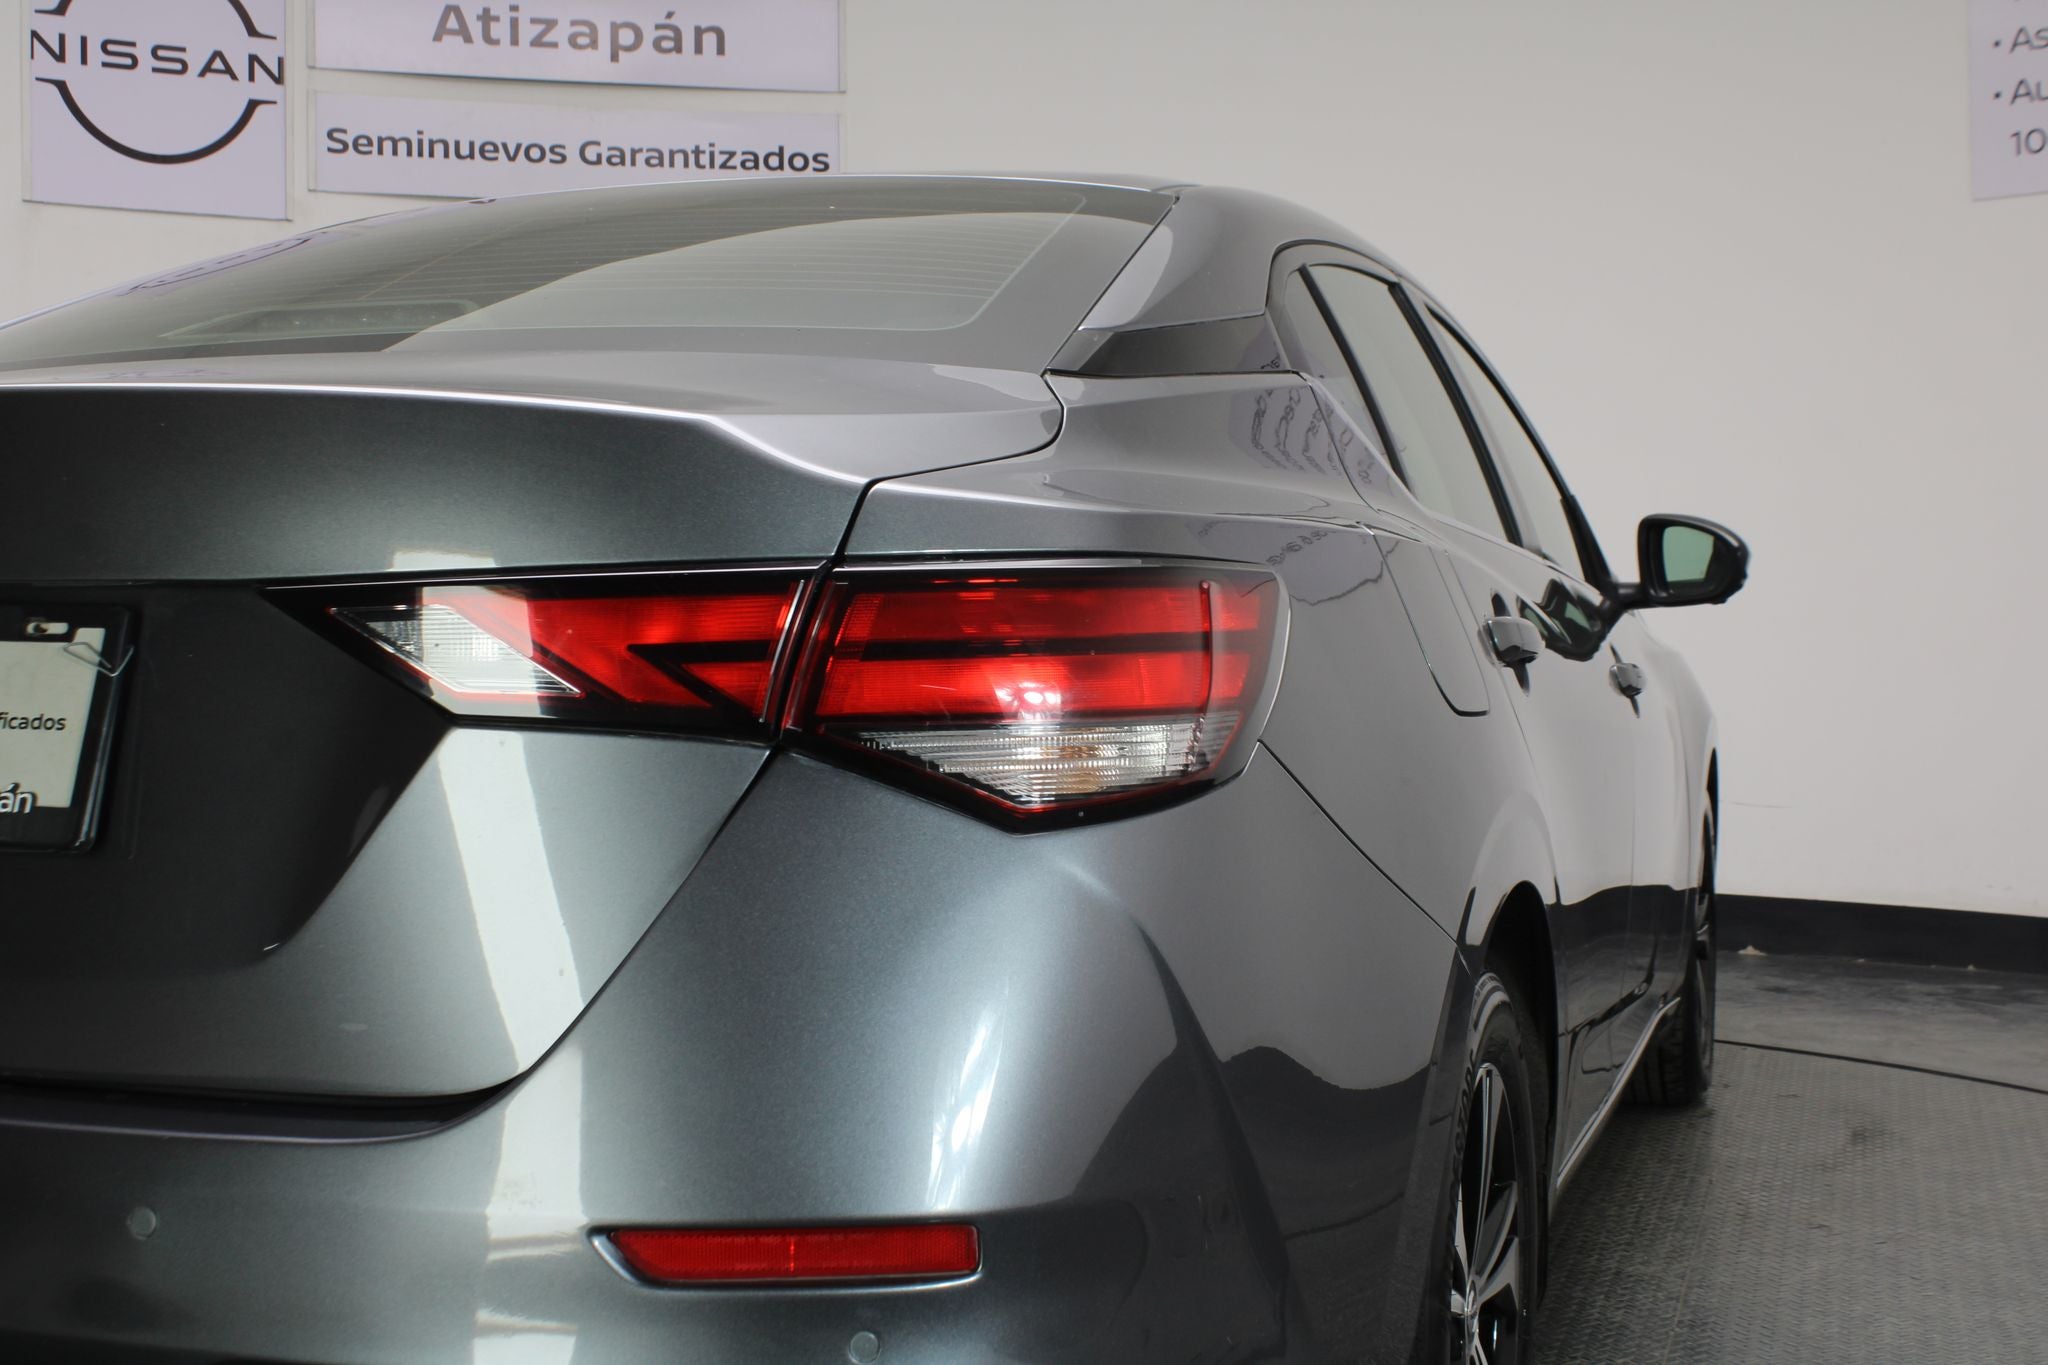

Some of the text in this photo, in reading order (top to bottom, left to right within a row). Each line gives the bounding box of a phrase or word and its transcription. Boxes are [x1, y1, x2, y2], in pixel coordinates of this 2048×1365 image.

[30, 29, 284, 86] NISSAN
[432, 4, 726, 63] Atizapán
[326, 127, 831, 173] Seminuevos Garantizados
